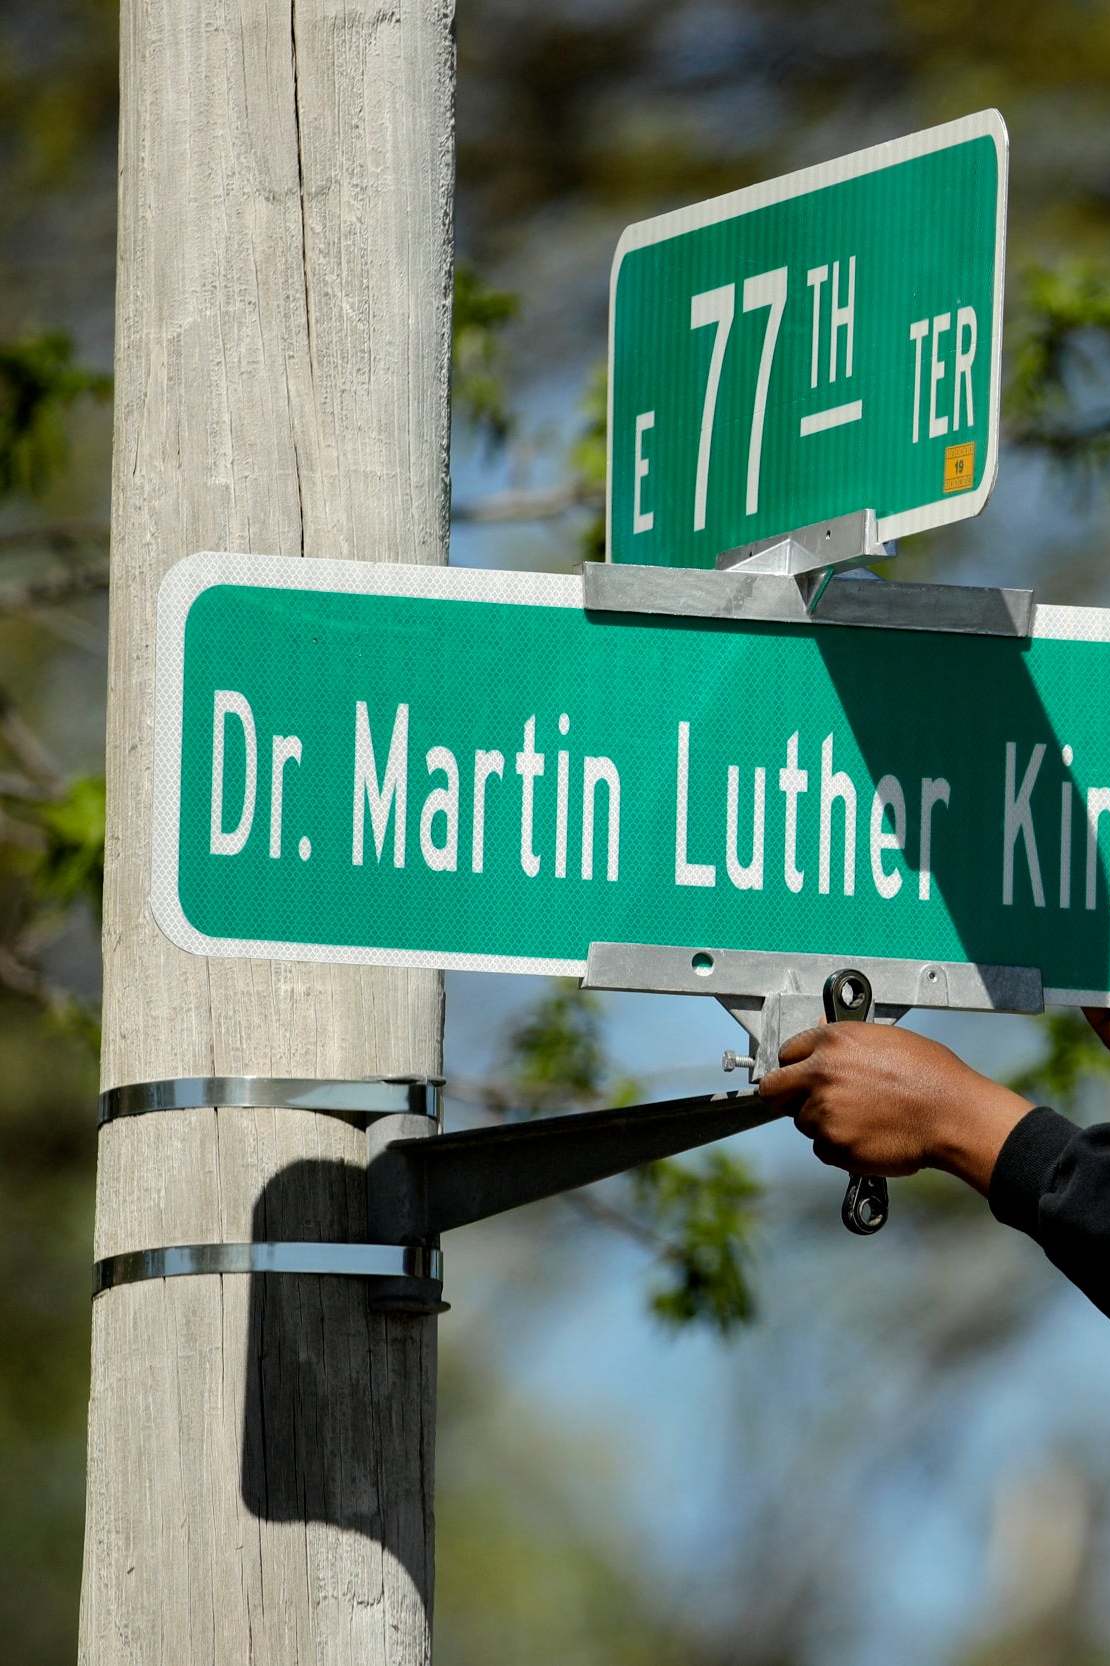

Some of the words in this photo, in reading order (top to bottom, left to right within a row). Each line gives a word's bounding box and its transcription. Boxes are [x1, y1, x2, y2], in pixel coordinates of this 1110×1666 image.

[633, 410, 655, 534] E
[909, 305, 978, 443] TER
[209, 689, 312, 862] Dr.
[351, 700, 622, 882] Martin
[674, 720, 951, 901] Luther
